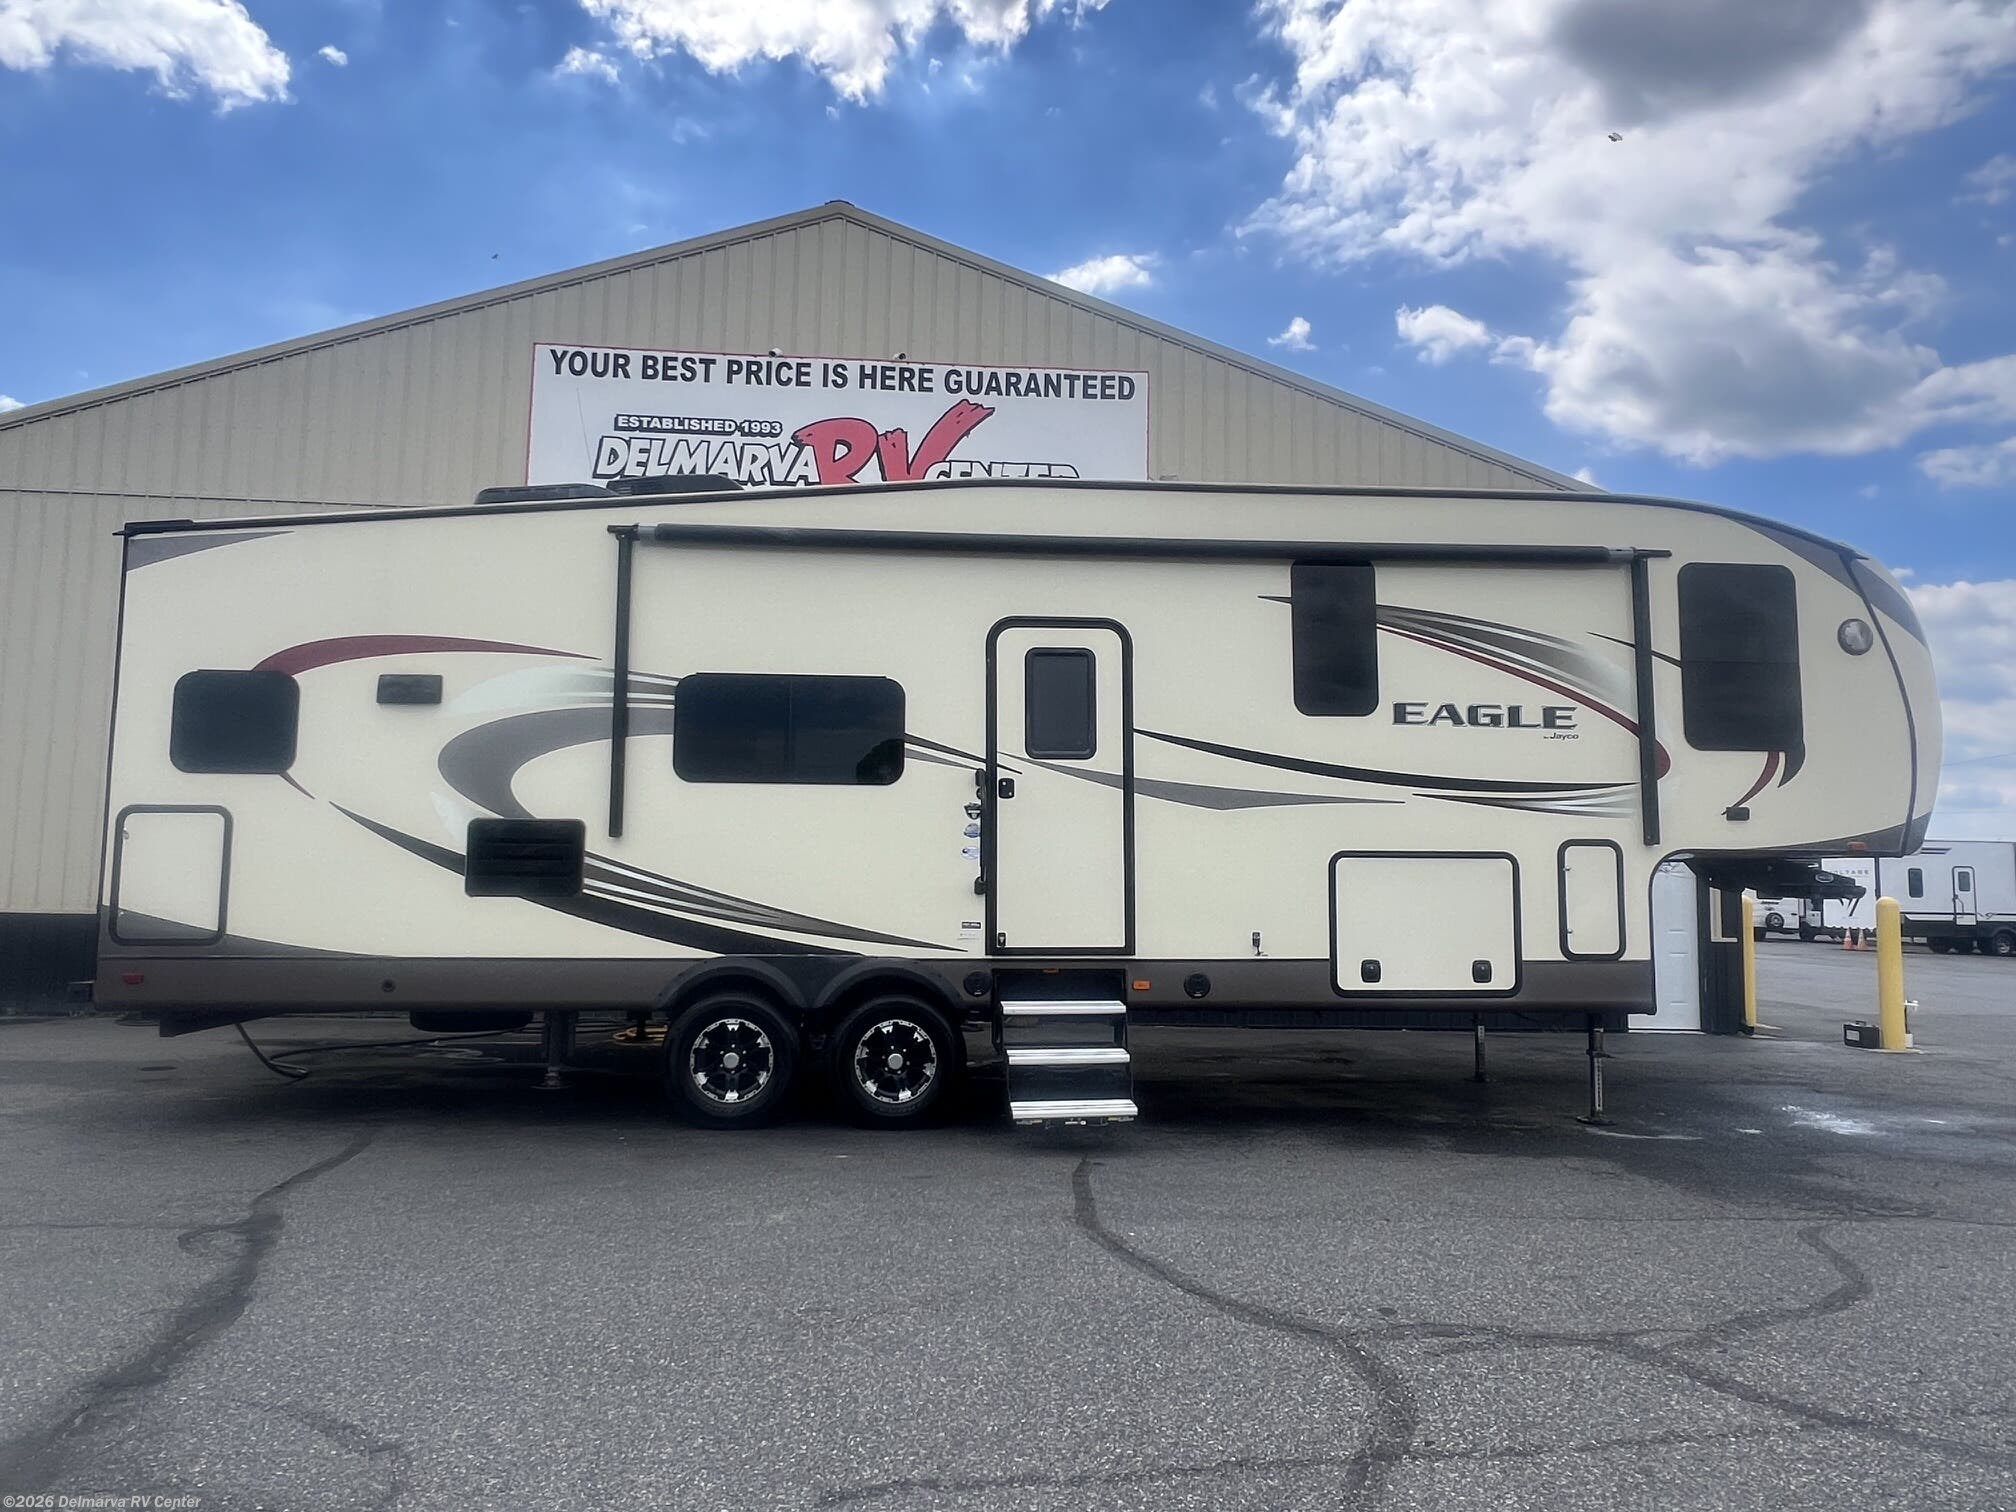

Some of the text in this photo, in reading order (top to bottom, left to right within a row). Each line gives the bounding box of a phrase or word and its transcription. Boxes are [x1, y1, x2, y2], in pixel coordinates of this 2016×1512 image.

[550, 349, 1136, 401] YOUR BEST PRICE IS HERE GUARANTEED
[615, 414, 783, 435] ESTABLISHED 1993
[592, 436, 822, 486] DELMARVA
[1392, 702, 1577, 730] EAGLE
